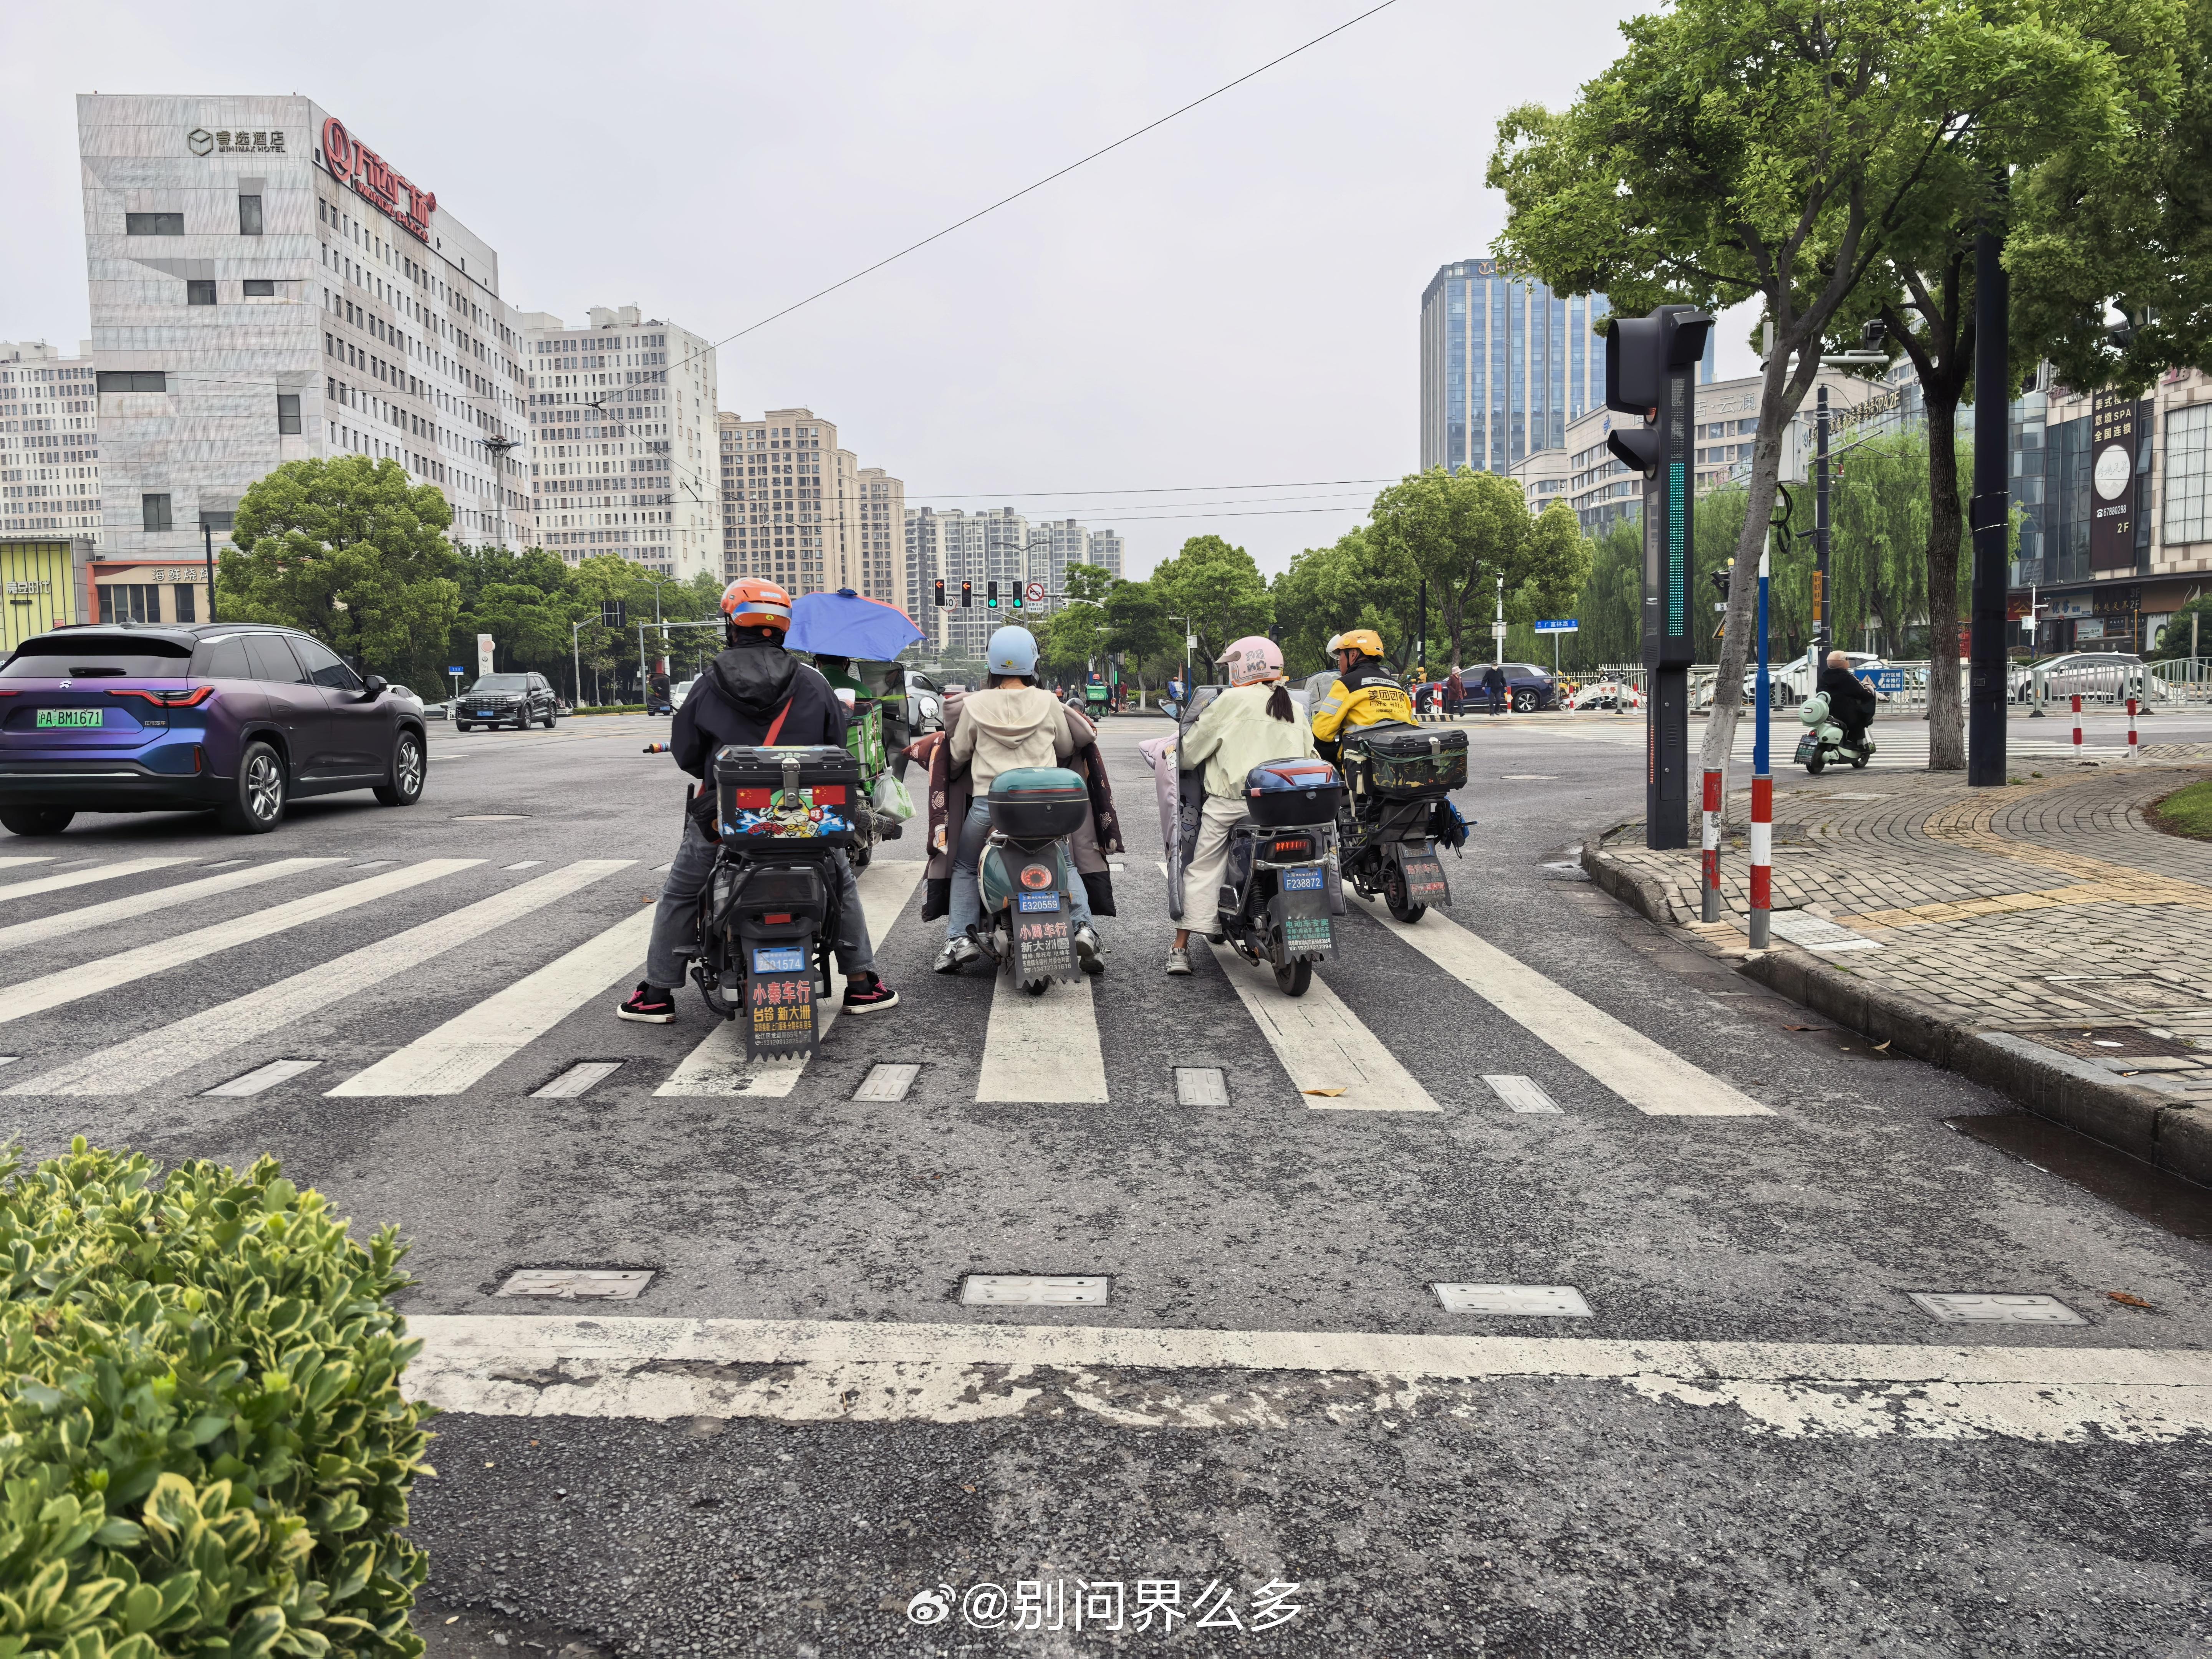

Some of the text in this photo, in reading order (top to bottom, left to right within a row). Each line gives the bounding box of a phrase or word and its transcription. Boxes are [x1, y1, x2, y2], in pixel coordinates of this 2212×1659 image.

[216, 131, 284, 145] 睿选酒店
[351, 139, 429, 228] 万达广场
[354, 179, 429, 243] WANDA PLAZA
[2094, 422, 2131, 442] 全国连锁
[2103, 505, 2126, 517] 67880288
[2117, 522, 2129, 533] 2F
[2130, 600, 2140, 609] 2F
[1368, 690, 1404, 704] 美团团购
[58, 711, 100, 725] BM1671
[1286, 878, 1321, 889] F238872
[1023, 901, 1057, 910] E320559
[1286, 919, 1329, 928] 电动车专卖
[1020, 922, 1067, 940] 小周车行
[1021, 939, 1056, 952] 新大洲
[754, 1005, 811, 1022] 台铃 新大洲
